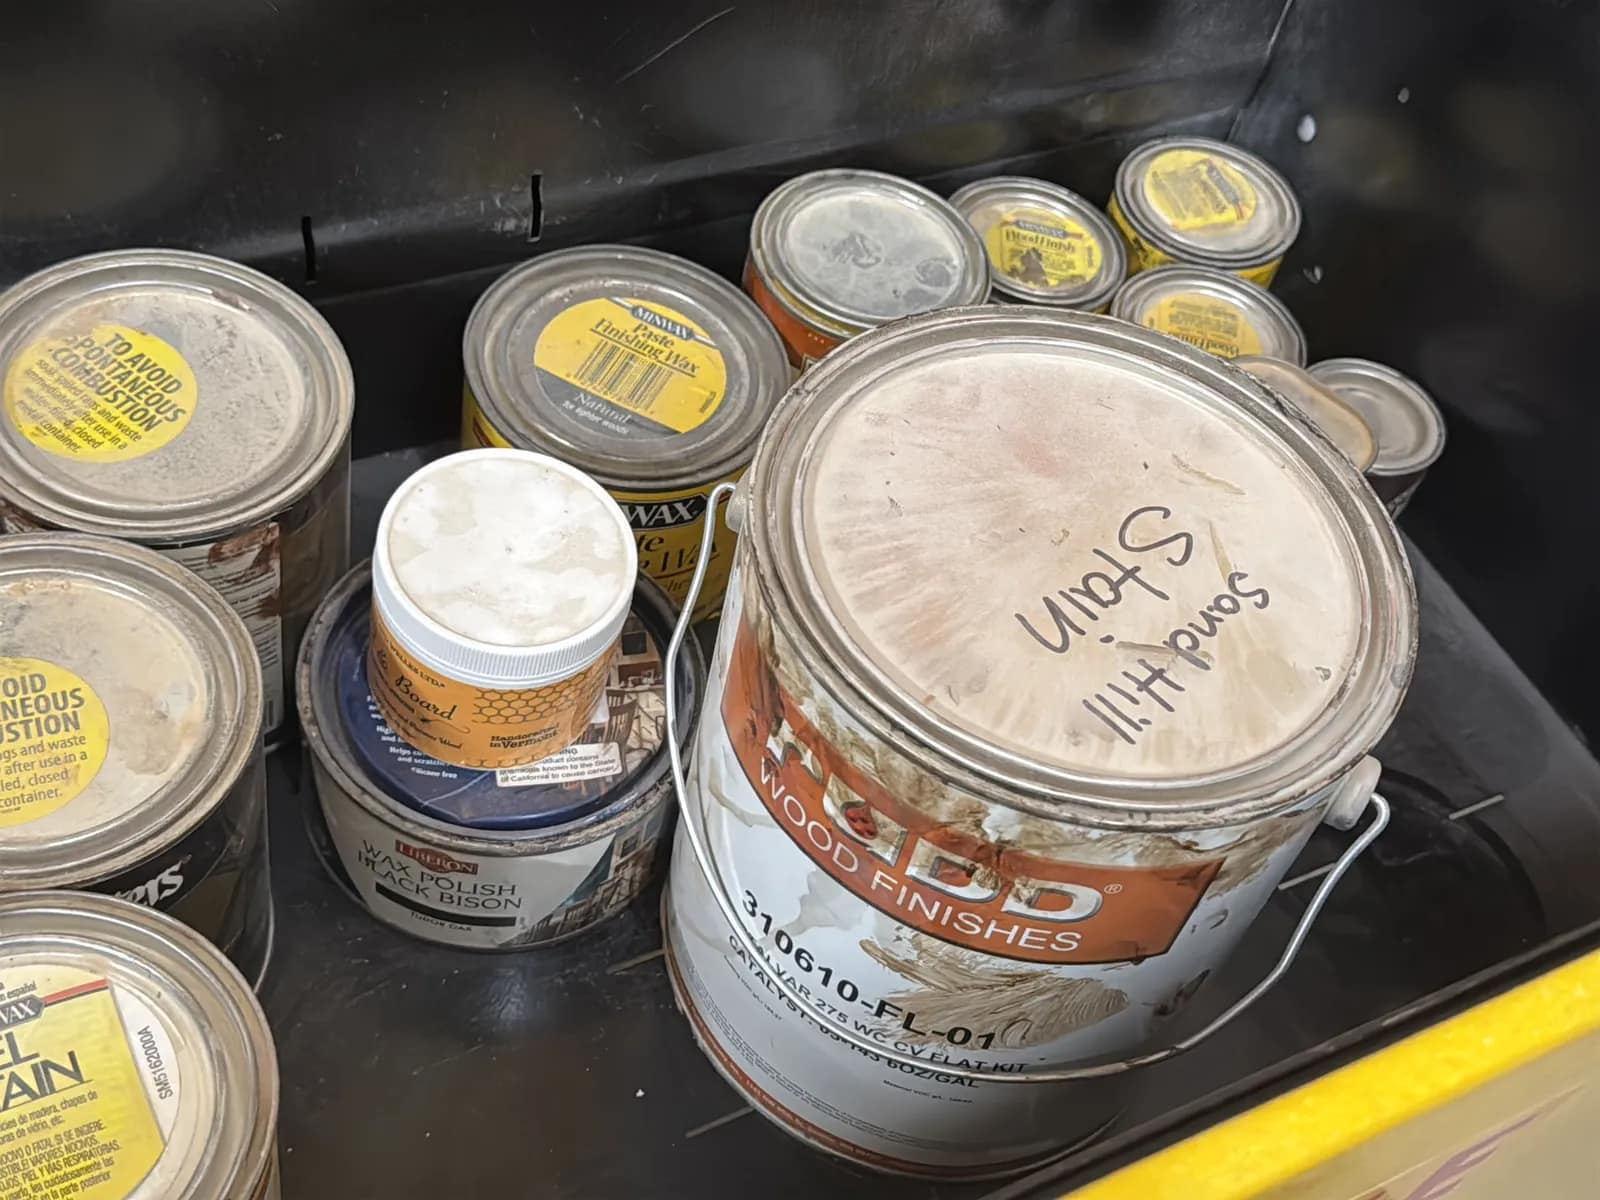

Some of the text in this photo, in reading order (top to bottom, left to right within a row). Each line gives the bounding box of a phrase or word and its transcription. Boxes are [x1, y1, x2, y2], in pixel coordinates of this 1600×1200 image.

[632, 322, 675, 348] Paste
[635, 307, 690, 339] MINWAX
[105, 332, 183, 394] TO AVOID
[594, 318, 700, 374] Finishing Wax
[52, 347, 164, 432] COMBUSTION
[99, 406, 117, 423] and
[115, 420, 142, 442] waste
[574, 392, 633, 424] Natural
[40, 418, 82, 453] container.
[72, 426, 104, 449] closed
[76, 408, 96, 428] after
[94, 421, 113, 438] use
[109, 432, 122, 445] in
[1014, 505, 1194, 654] Stain
[0, 688, 85, 720] NEOUS
[395, 674, 458, 721] Board
[1082, 658, 1186, 745] Hill
[20, 741, 45, 756] and
[48, 735, 87, 751] waste
[501, 729, 558, 749] Vermont
[5, 751, 88, 775] after use in a
[28, 768, 70, 786] closed
[511, 774, 550, 783] California
[542, 764, 568, 772] known
[363, 839, 517, 896] WAX POLISH
[760, 755, 1082, 954] WOOD FINISHES
[439, 891, 522, 910] BISON
[743, 889, 996, 1051] 310610-FL-01
[815, 997, 849, 1025] 275
[853, 1020, 889, 1045] WC
[893, 1039, 925, 1058] CV
[929, 1048, 989, 1073] FLAT
[990, 1061, 1030, 1074] KIT
[136, 1024, 174, 1100] SM5162000A
[0, 1049, 85, 1112] AIN
